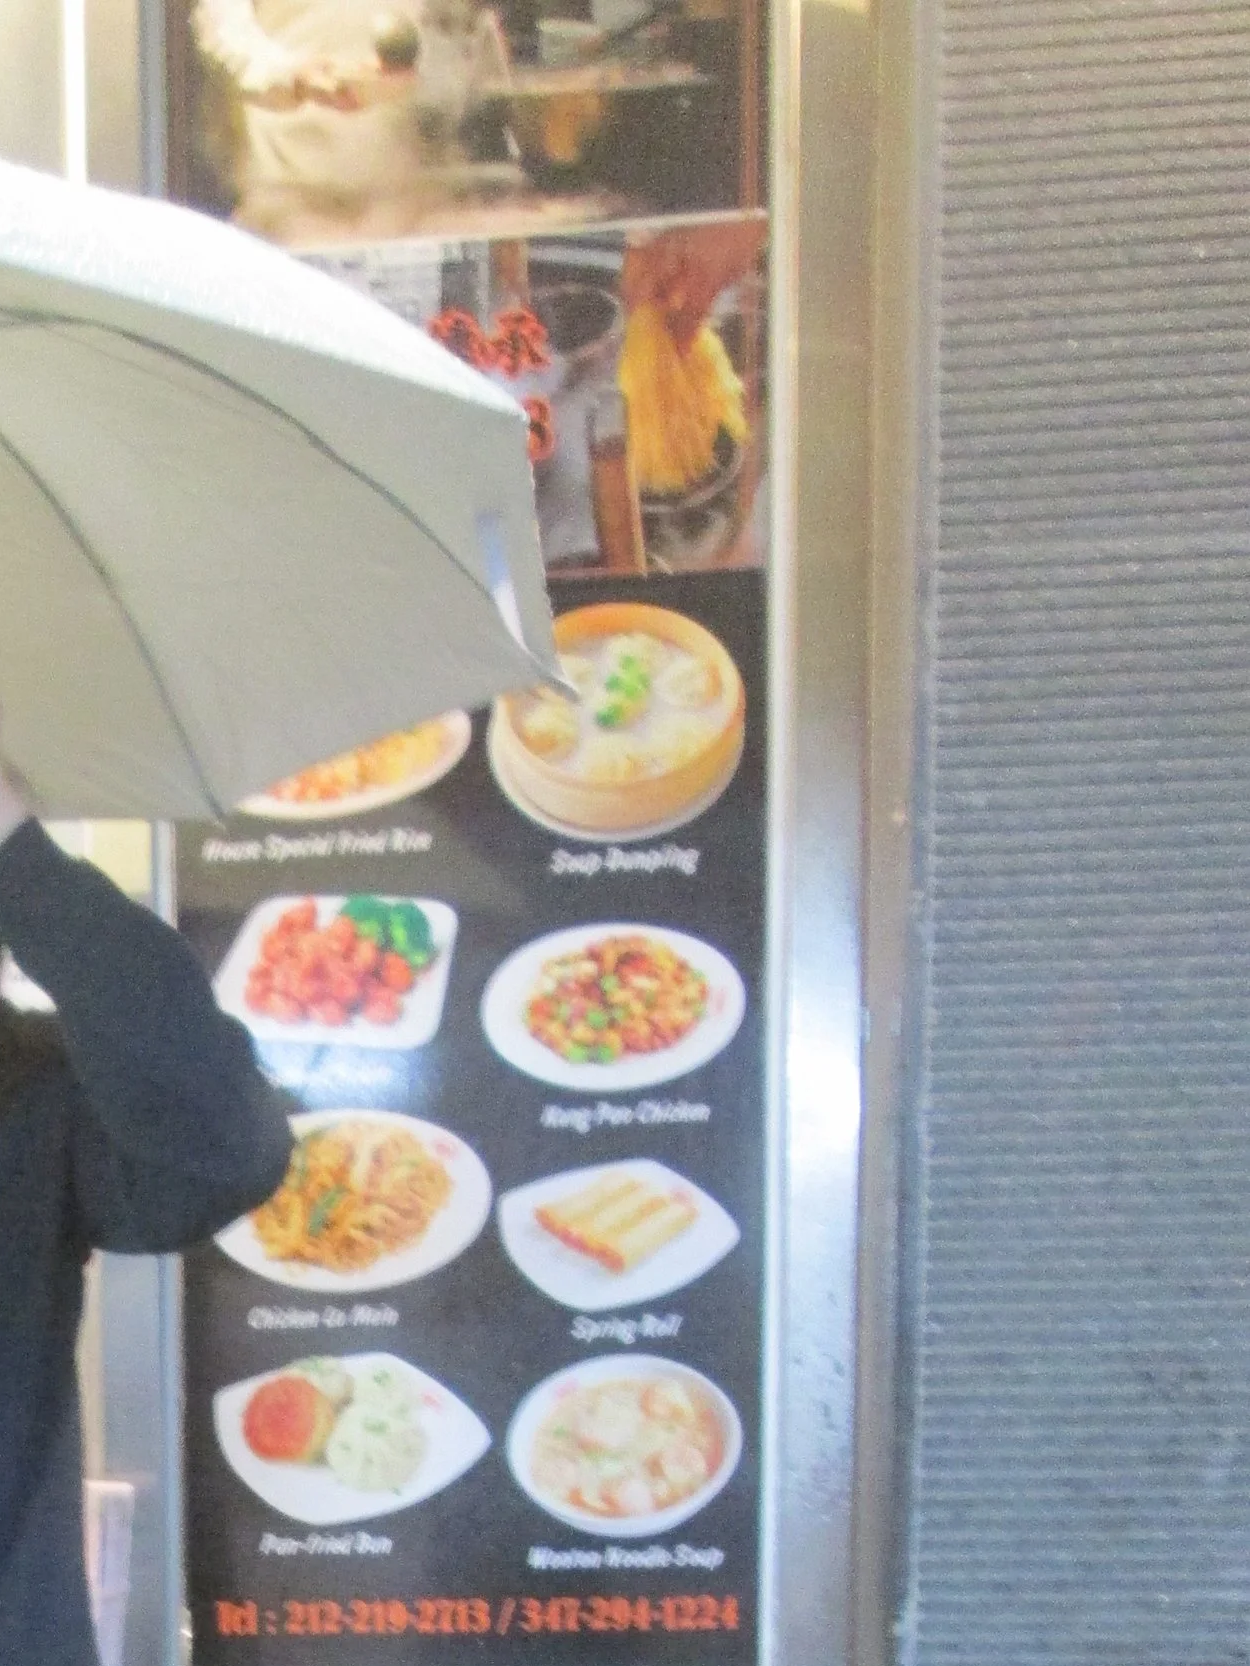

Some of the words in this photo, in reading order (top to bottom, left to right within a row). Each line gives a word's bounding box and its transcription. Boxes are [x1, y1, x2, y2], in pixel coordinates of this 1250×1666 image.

[264, 832, 335, 862] Special
[337, 829, 387, 854] Fried
[391, 826, 432, 852] Rice
[550, 848, 602, 876] Soup
[606, 844, 699, 875] Dumpling
[635, 1099, 710, 1123] Chicken
[247, 1305, 319, 1329] Chicken
[322, 1305, 347, 1328] Lo
[351, 1302, 399, 1327] Mein
[570, 1315, 636, 1345] Spring
[641, 1313, 683, 1338] Roll
[528, 1545, 602, 1570] Wonton
[605, 1544, 670, 1569] Noodle
[671, 1543, 724, 1571] Soup
